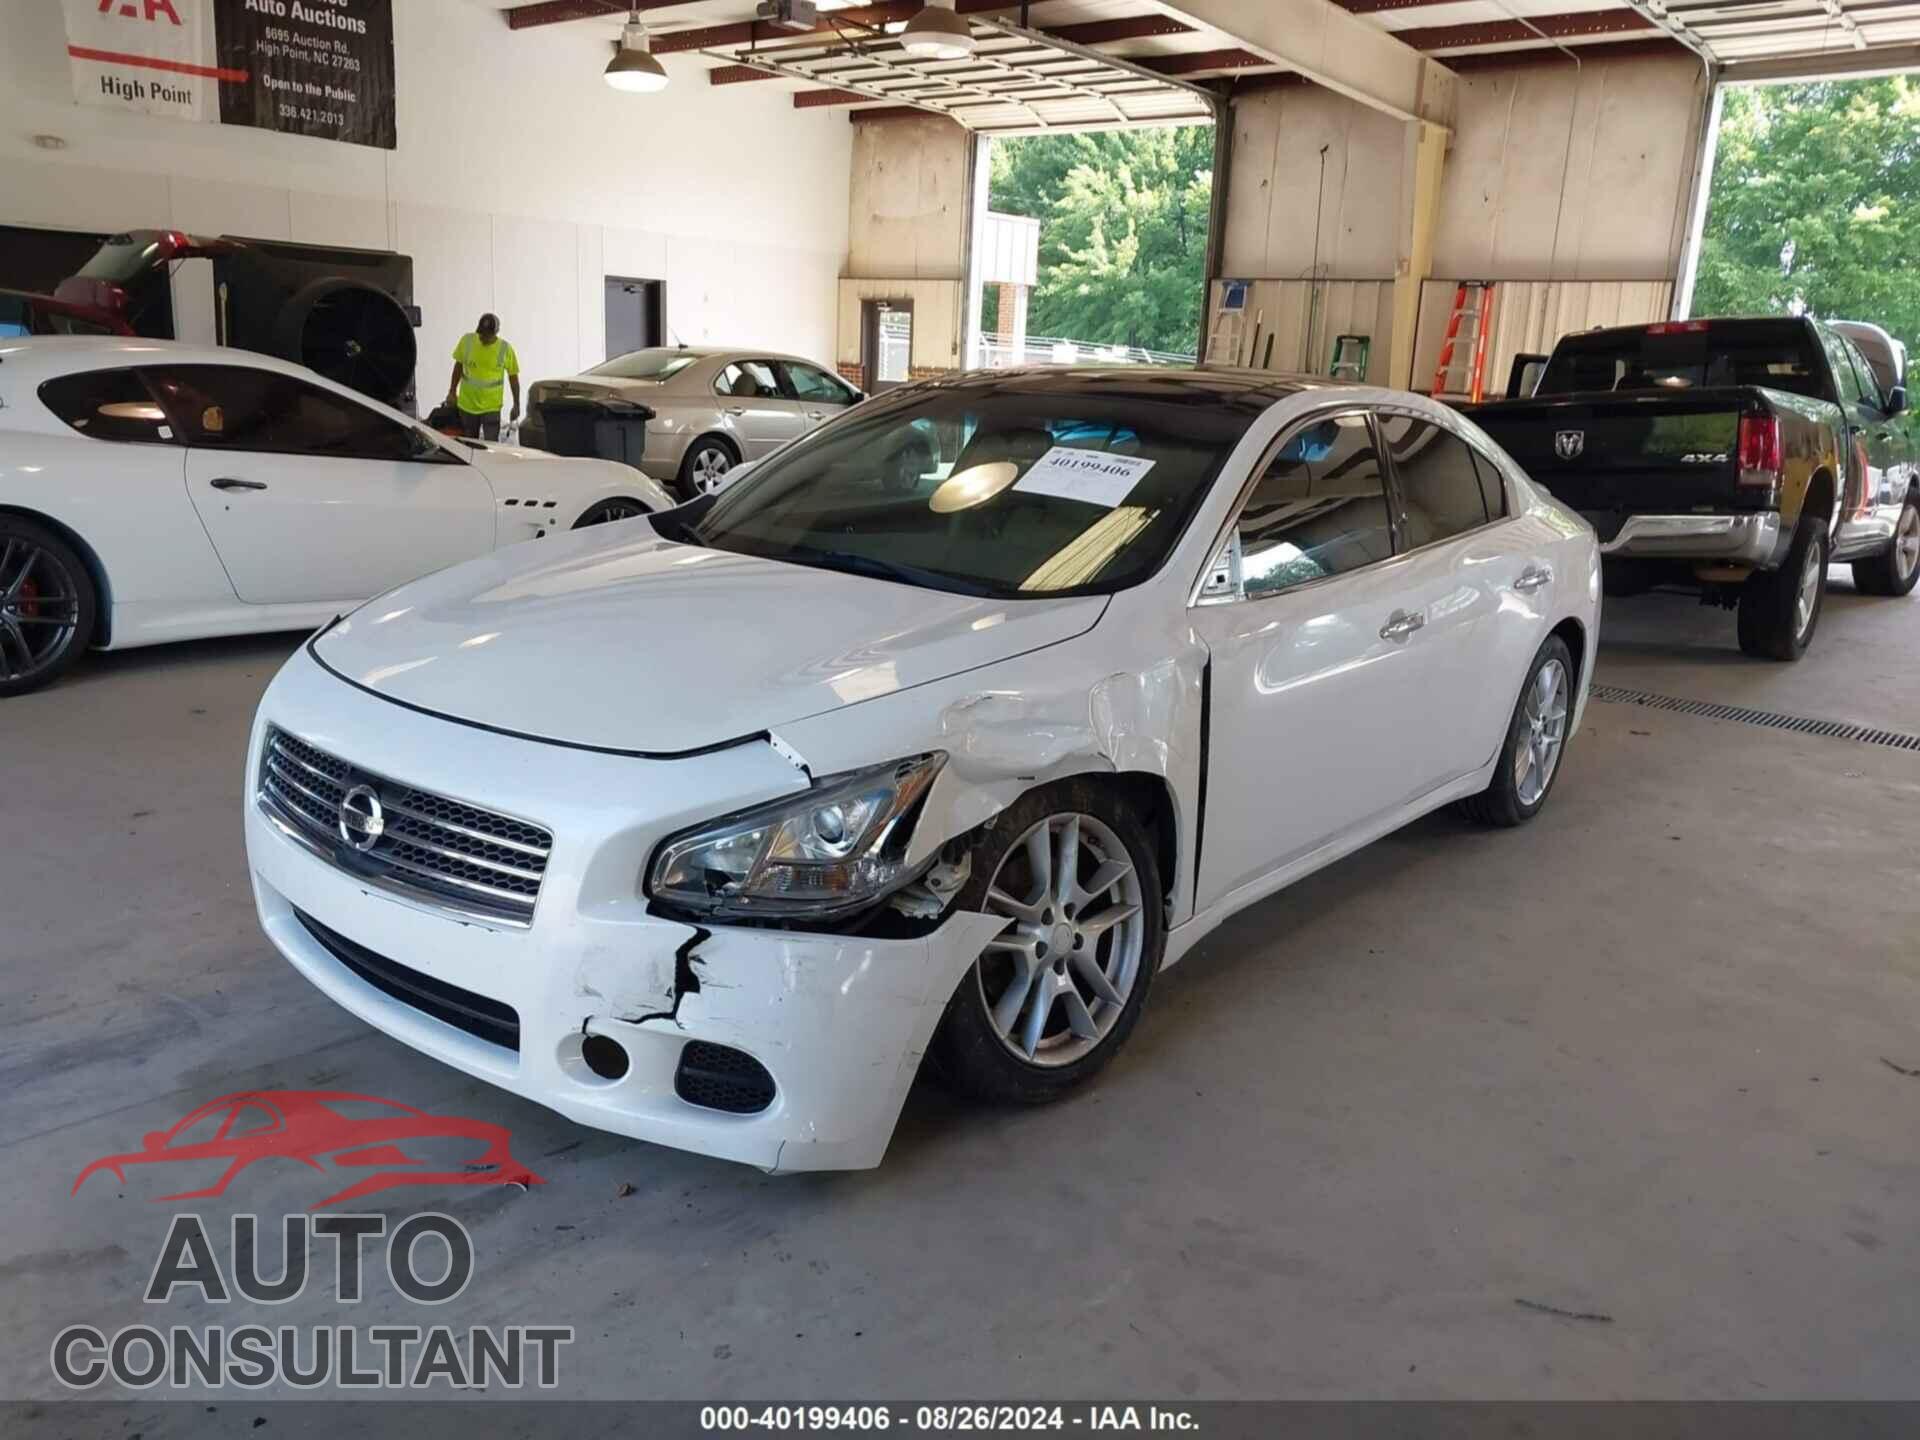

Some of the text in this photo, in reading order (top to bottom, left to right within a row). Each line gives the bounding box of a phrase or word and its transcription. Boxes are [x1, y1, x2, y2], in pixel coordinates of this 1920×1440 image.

[244, 0, 367, 34] Auto Auctions
[256, 40, 280, 57] High
[313, 50, 329, 65] NC
[292, 32, 332, 51] Auction
[101, 75, 192, 104] High Point
[263, 74, 357, 102] Open to the Public
